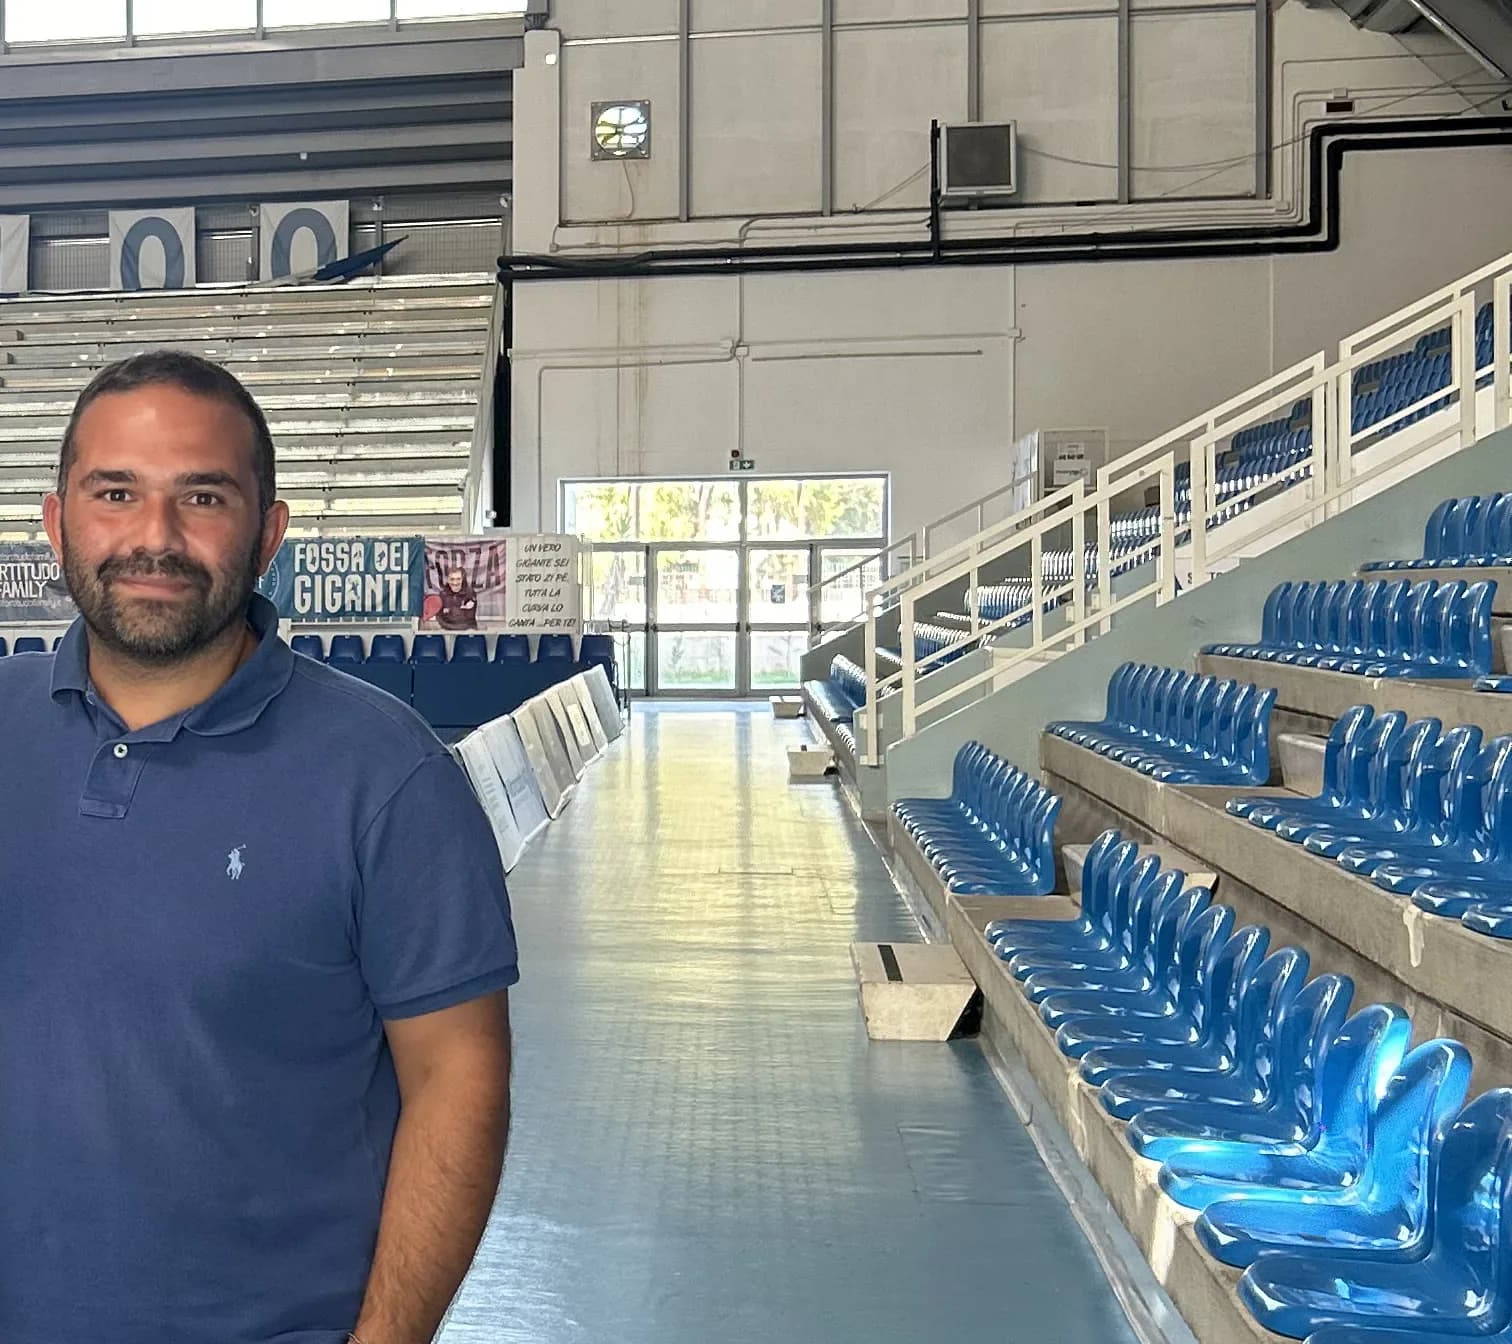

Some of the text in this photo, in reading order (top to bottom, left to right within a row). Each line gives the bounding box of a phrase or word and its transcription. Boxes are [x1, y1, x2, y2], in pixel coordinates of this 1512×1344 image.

[538, 543, 562, 553] VERO
[294, 541, 409, 573] FOSSA DEI
[515, 558, 570, 568] GIGANTE SEI
[515, 573, 542, 583] STATO
[294, 573, 409, 614] GIGANTI
[524, 588, 561, 597] TUTTA LA
[522, 603, 564, 613] CURVA LO
[508, 618, 536, 627] CANTA
